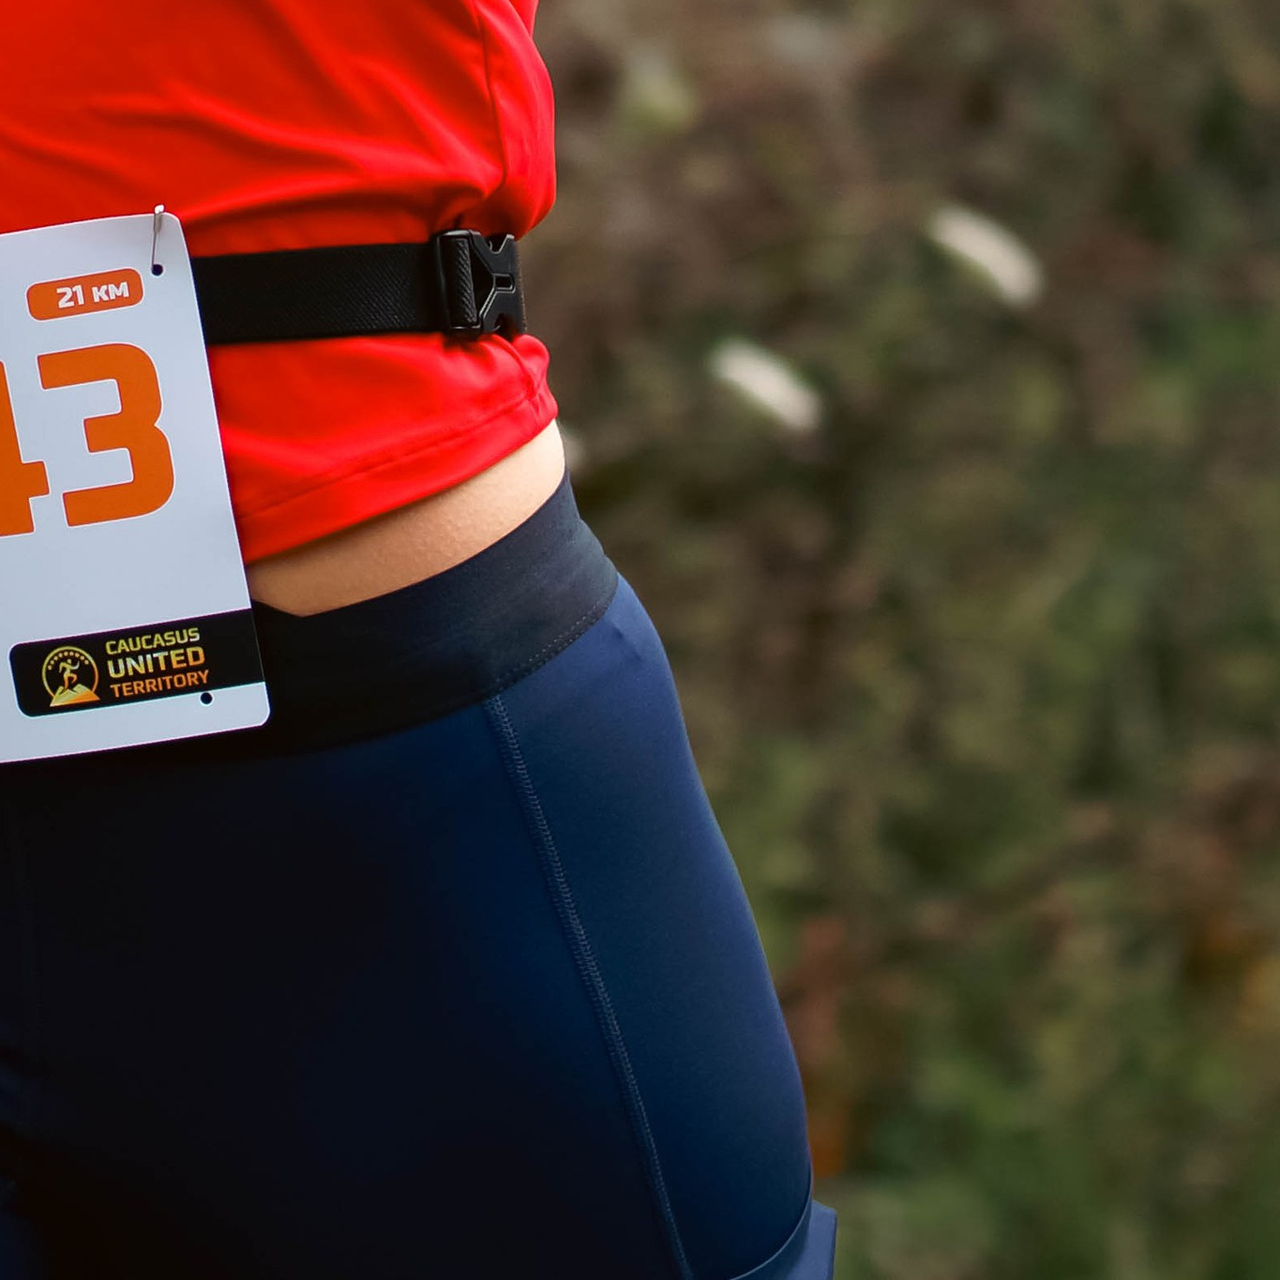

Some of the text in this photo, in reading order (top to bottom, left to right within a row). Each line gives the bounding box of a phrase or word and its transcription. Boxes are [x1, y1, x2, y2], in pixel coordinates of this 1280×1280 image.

[56, 284, 85, 309] 21
[105, 627, 201, 655] CAUCASUS
[107, 646, 206, 679] UNITED
[110, 669, 210, 698] TERRITORY
